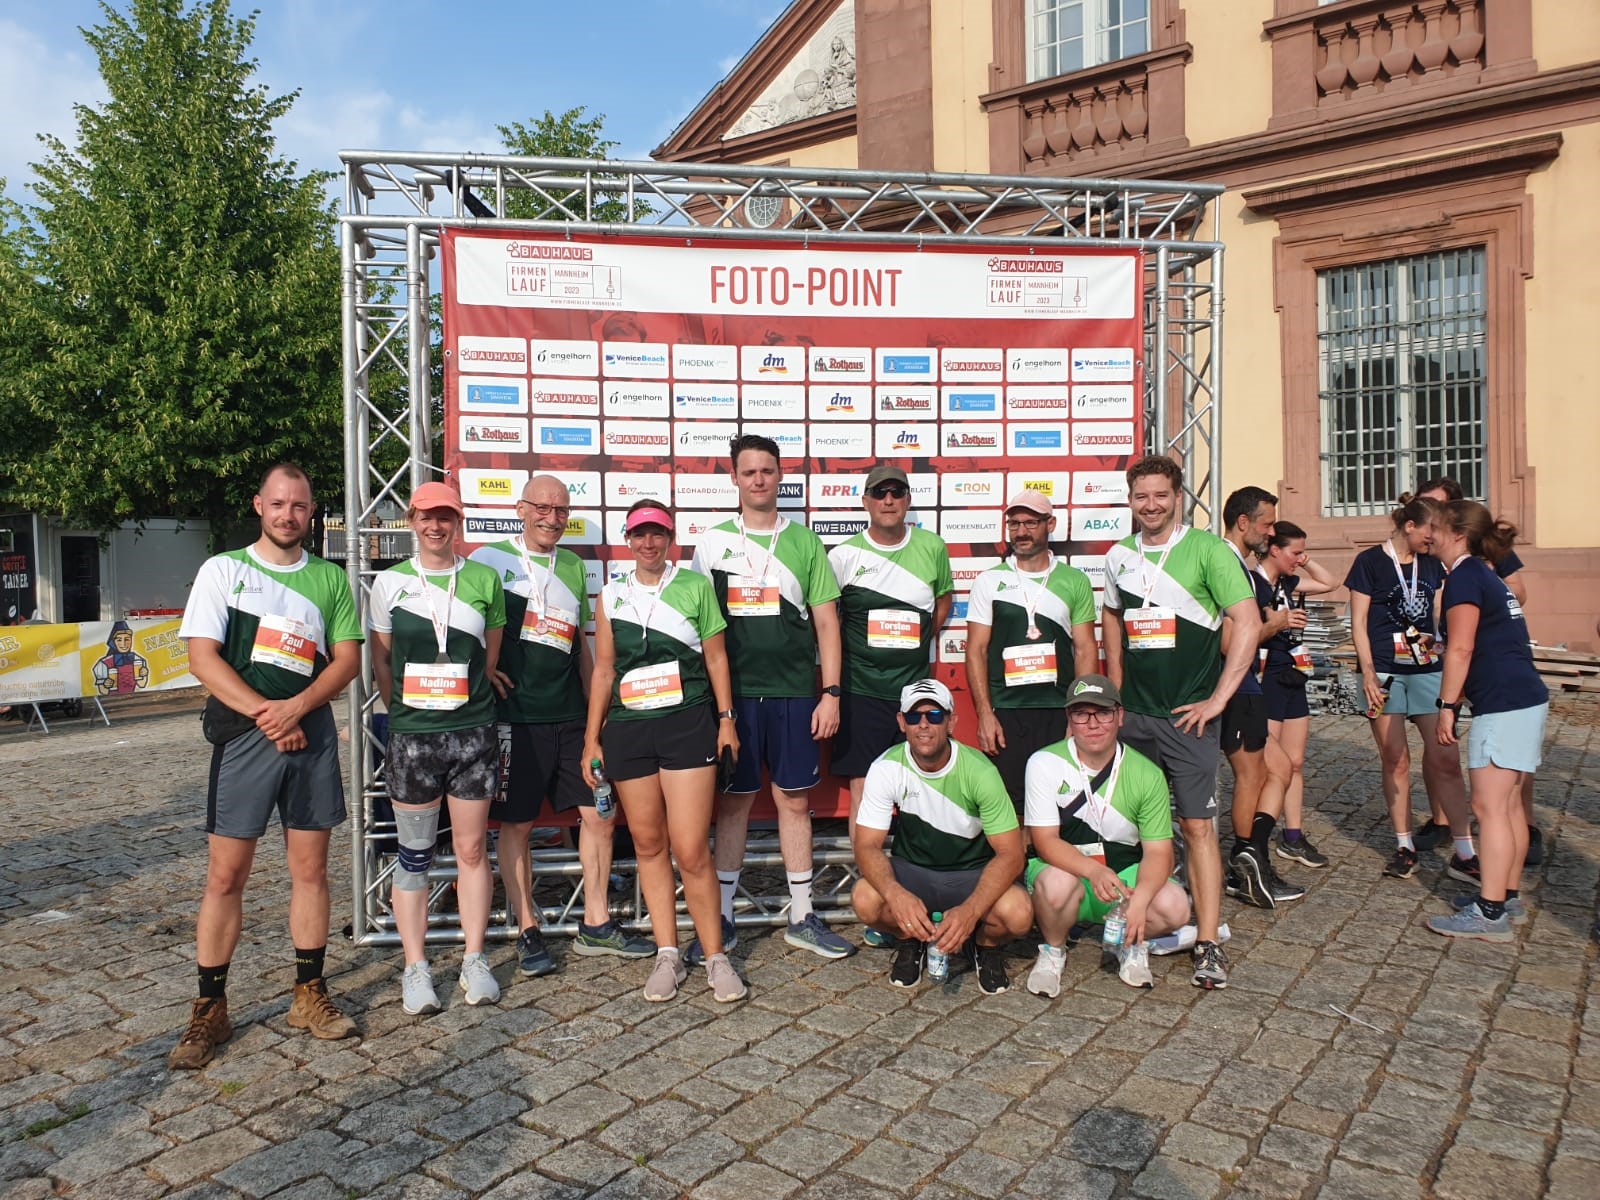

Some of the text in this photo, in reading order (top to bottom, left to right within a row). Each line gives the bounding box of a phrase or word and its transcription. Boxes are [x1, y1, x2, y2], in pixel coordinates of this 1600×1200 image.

[521, 246, 592, 260] BAUHAUS
[511, 266, 547, 277] FIRMEN
[1000, 261, 1063, 272] BAUHAUS
[554, 270, 589, 279] MANNHEIM
[511, 278, 547, 292] LAUF
[710, 265, 902, 307] FOTO-POINT
[991, 280, 1022, 289] FIRMEN
[1028, 282, 1059, 290] MANNHEIM
[564, 286, 580, 295] 2023
[991, 290, 1022, 304] LAUF
[1036, 297, 1050, 305] 2023
[470, 350, 525, 362] BAUHAUS
[550, 353, 592, 361] engelhorn
[763, 353, 785, 367] dm
[679, 359, 714, 367] PHOENIX
[829, 357, 864, 371] Rothaus
[952, 362, 1001, 371] BAUHAUS
[1024, 359, 1062, 368] engelhorn
[543, 393, 598, 404] BAUHAUS
[622, 393, 663, 402] engelhorn
[748, 399, 783, 407] PHOENIX
[830, 393, 852, 406] dm
[895, 396, 930, 409] Rothaus
[1089, 396, 1127, 404] engelhorn
[1018, 399, 1067, 408] BAUHAUS
[481, 428, 520, 441] Rothaus
[616, 434, 669, 445] BAUHAUS
[896, 430, 918, 444] dm
[1083, 435, 1132, 445] BAUHAUS
[815, 438, 849, 446] PHOENIX
[961, 434, 996, 447] Rothaus
[480, 480, 509, 489] KAHL
[568, 482, 587, 495] AX
[1025, 482, 1051, 490] KAHL
[1083, 517, 1120, 530] ABAX
[880, 621, 911, 631] Torsten
[1132, 620, 1162, 630] Dennis
[280, 632, 305, 649] Paul
[1014, 655, 1046, 667] Marcel
[419, 677, 457, 689] Nadine
[631, 676, 669, 691] Melanie
